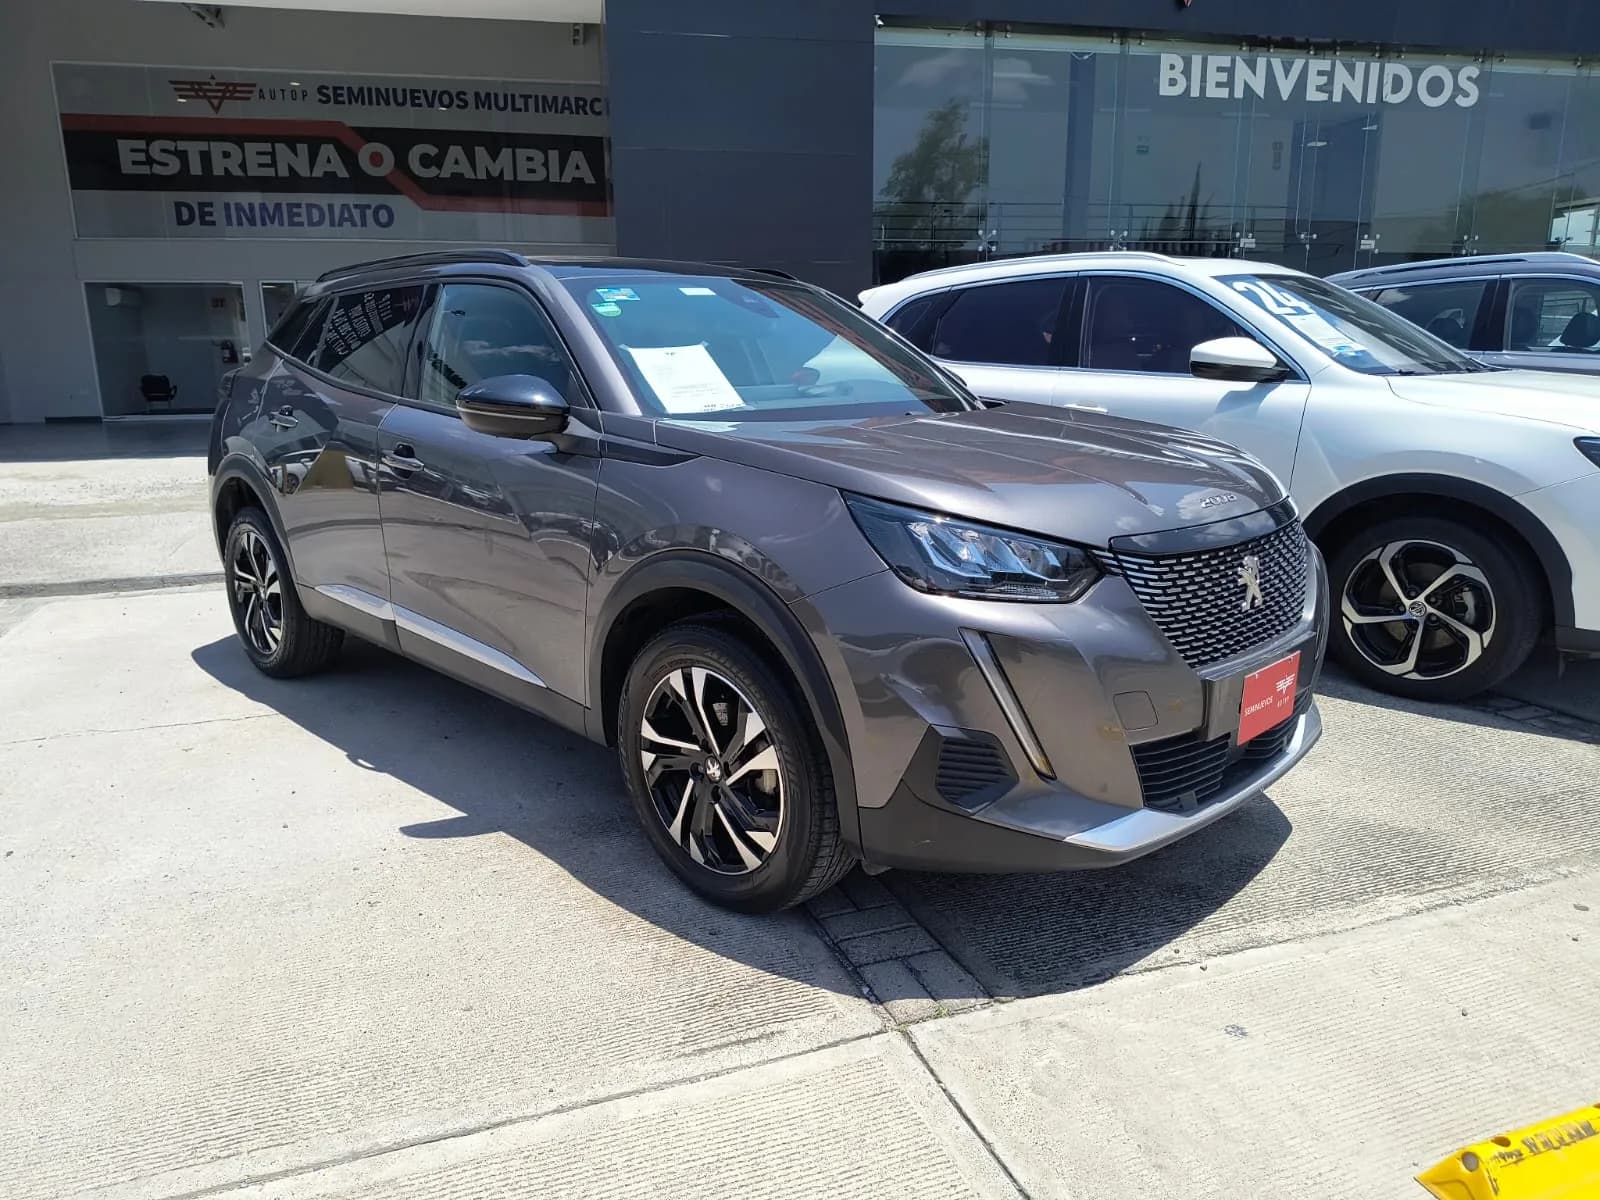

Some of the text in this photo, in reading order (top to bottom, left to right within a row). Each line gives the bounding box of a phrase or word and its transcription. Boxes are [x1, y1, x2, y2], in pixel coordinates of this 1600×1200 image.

[1158, 53, 1481, 107] BIENVENIDOS
[258, 84, 609, 116] AUTOP SEMINUEVOS MULTIMARC
[116, 138, 597, 185] ESTRENA O CAMBIA
[174, 201, 395, 229] DE INMEDIATO
